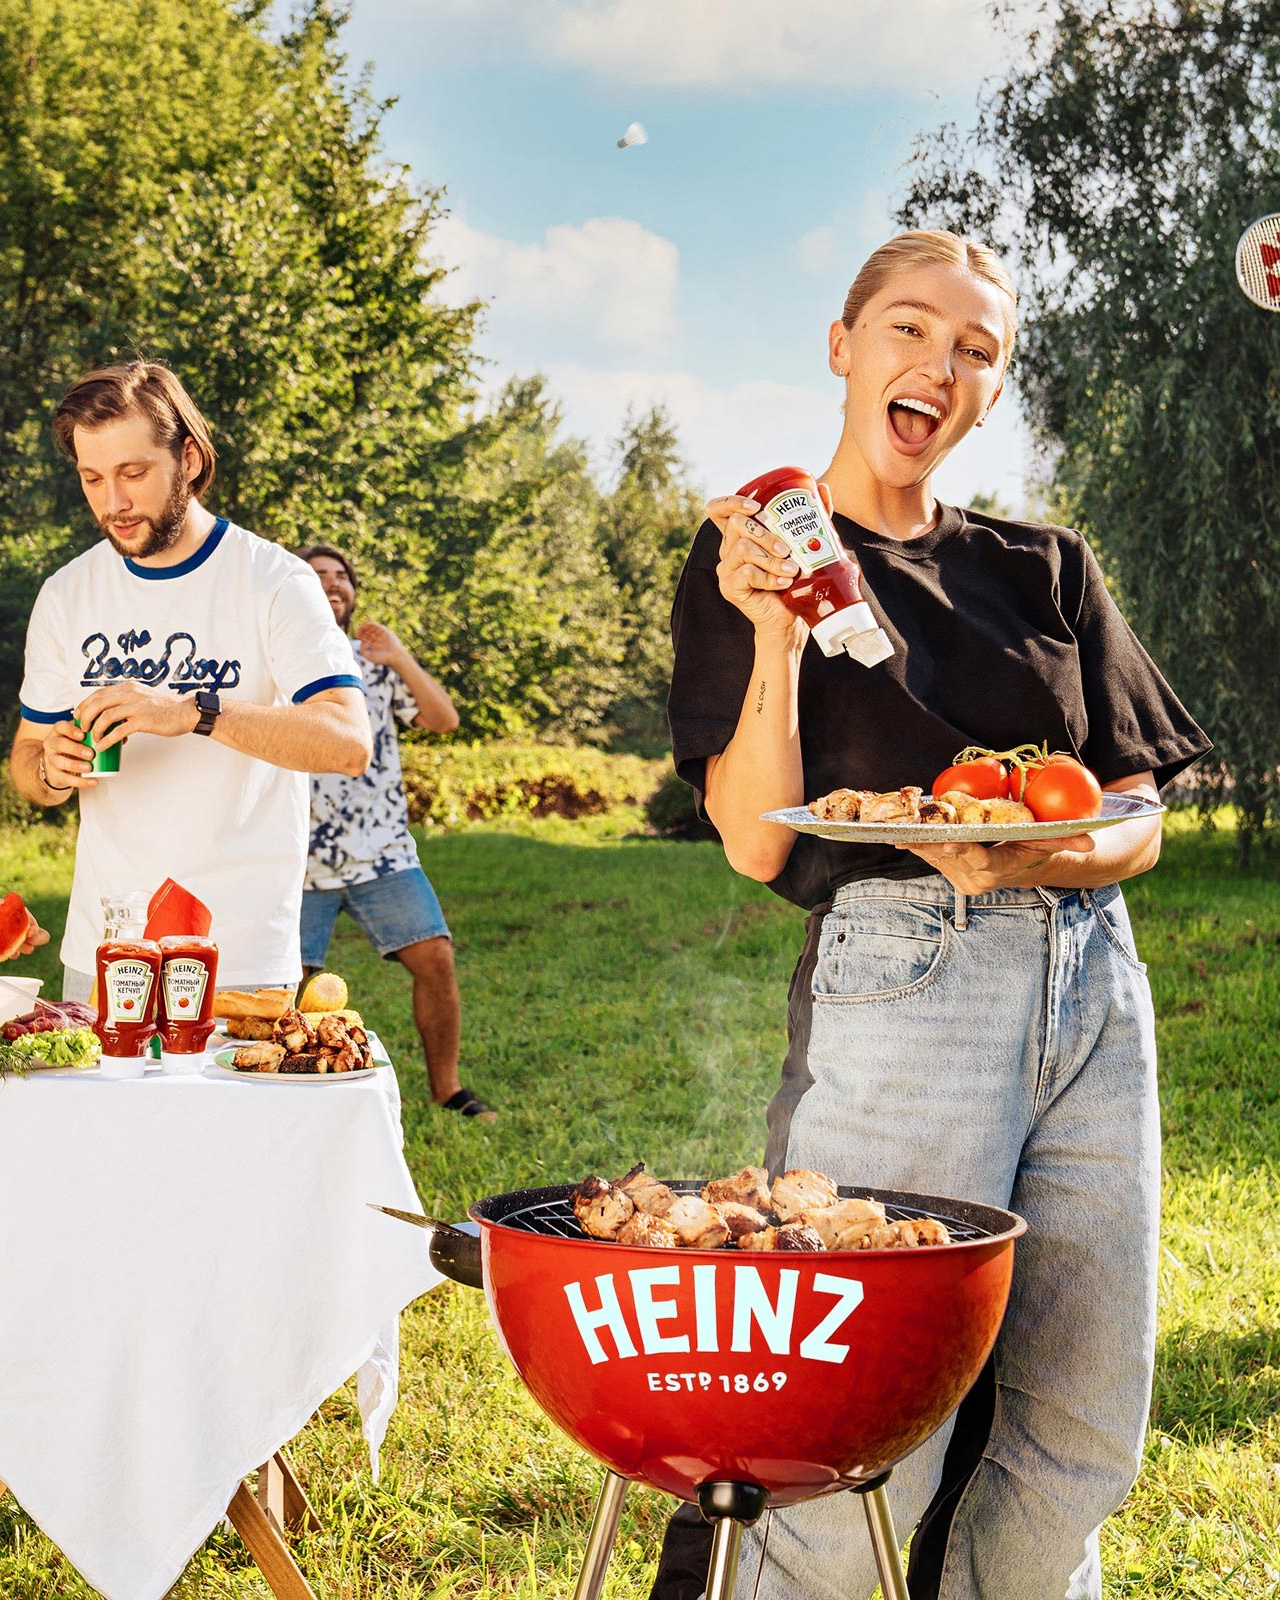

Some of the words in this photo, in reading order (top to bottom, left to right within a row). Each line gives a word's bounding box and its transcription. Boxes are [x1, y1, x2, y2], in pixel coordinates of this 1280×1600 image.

[776, 496, 807, 515] HEINZ
[779, 509, 819, 532] ТОМАТНЫЙ
[790, 520, 819, 537] КЕТЧУП
[117, 629, 151, 655] The
[80, 632, 170, 687] Beach
[165, 632, 241, 694] Boys
[756, 702, 764, 715] ALL
[117, 966, 143, 975] HEINZ
[172, 965, 198, 974] HEINZ
[113, 979, 146, 987] ТОМАТНЫЙ
[167, 977, 200, 986] ТОМАТНЫЙ
[172, 985, 195, 993] КЕТЧУП
[563, 1264, 865, 1365] HEINZ
[719, 1371, 788, 1394] 1869
